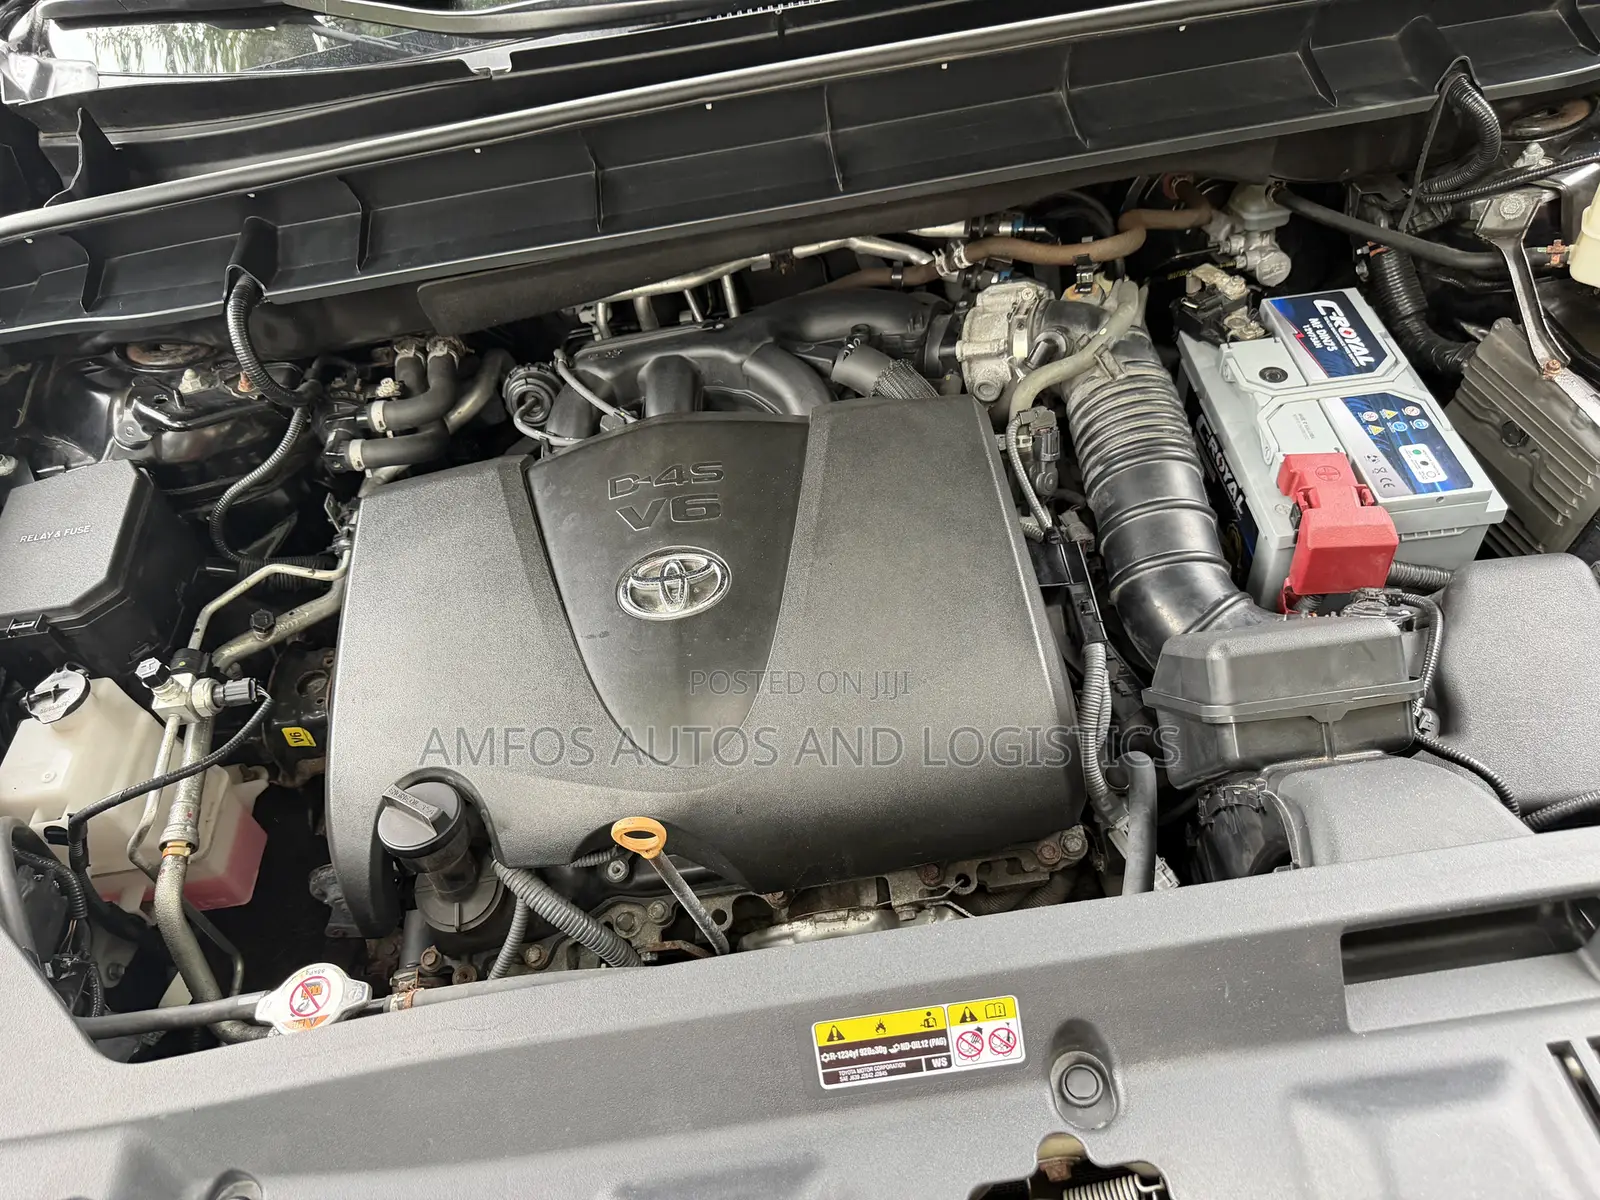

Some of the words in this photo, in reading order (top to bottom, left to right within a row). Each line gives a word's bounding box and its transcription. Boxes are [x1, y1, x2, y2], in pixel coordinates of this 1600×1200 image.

[608, 461, 725, 500] D-4S
[616, 493, 722, 532] V6
[20, 531, 54, 543] RELAY
[54, 530, 61, 538] &
[63, 525, 92, 537] FUSE
[290, 732, 304, 743] V6
[931, 1057, 948, 1068] WS
